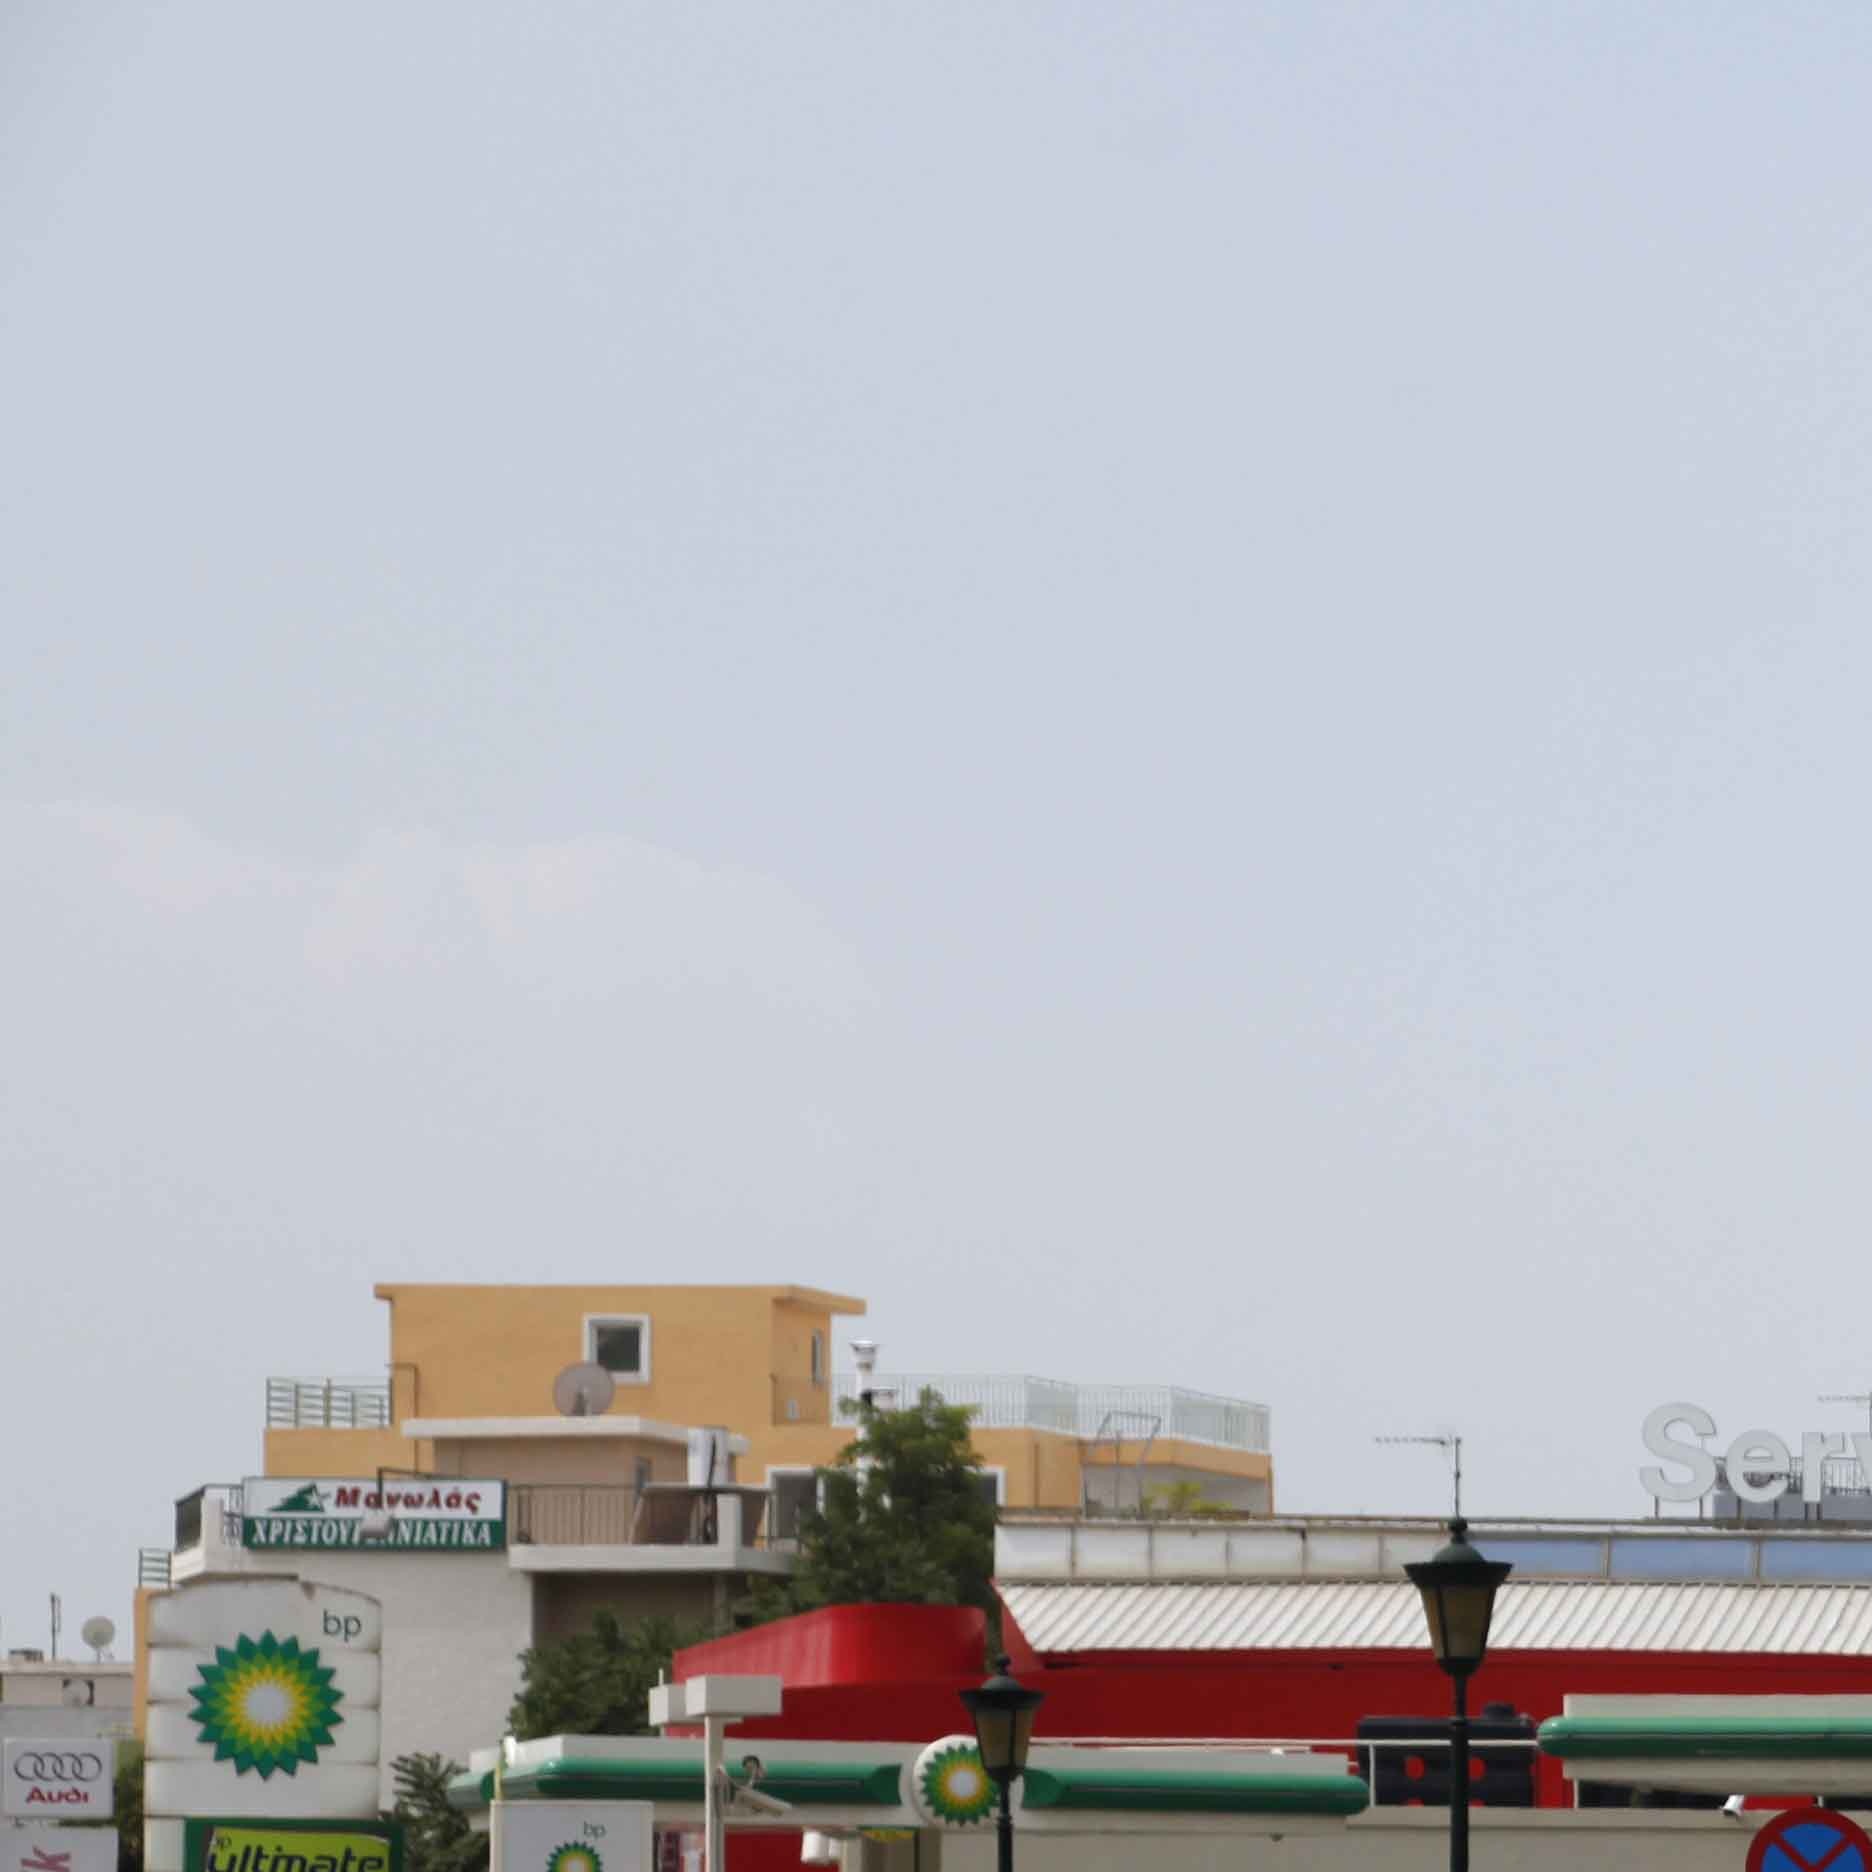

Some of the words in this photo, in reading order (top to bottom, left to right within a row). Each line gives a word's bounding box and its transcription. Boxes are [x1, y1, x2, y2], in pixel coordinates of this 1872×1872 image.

[335, 1486, 482, 1515] Μανωλάς
[253, 1518, 491, 1546] ΧΡΙΣΤΟΥΓΝΙΑΤΙΚΑ
[322, 1609, 362, 1645] bp
[26, 1786, 89, 1804] Audi
[583, 1821, 606, 1839] bp
